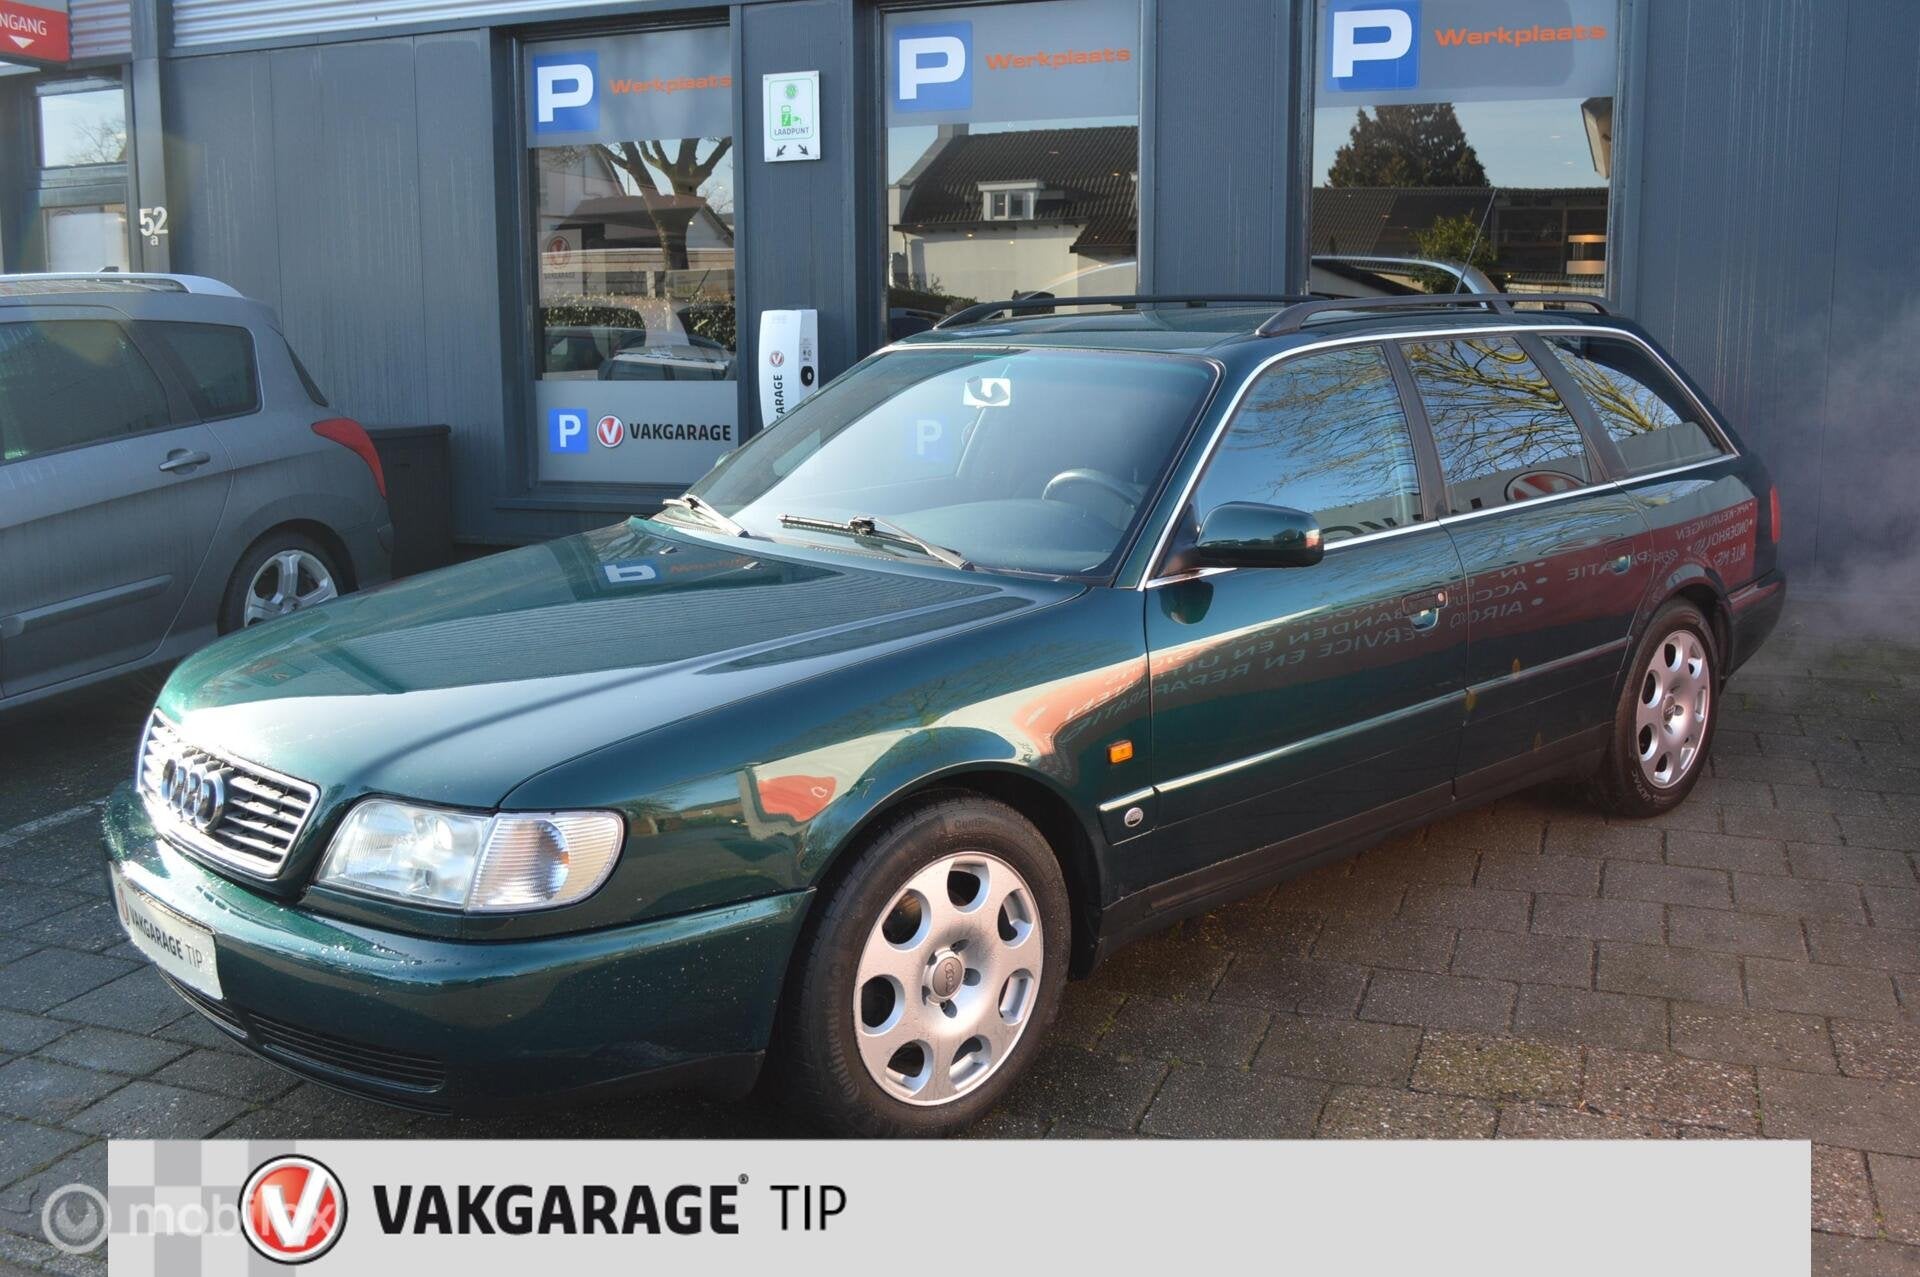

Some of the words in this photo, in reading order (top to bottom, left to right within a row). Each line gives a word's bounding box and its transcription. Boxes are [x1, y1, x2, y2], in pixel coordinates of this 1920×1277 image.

[1332, 9, 1413, 78] P
[1434, 23, 1607, 49] Werkplaats
[899, 35, 965, 99] P
[985, 46, 1131, 70] Werkplaats
[537, 64, 594, 122] P
[609, 75, 732, 96] Werkplaats
[774, 127, 809, 136] LAADPUNT
[139, 206, 168, 236] 52
[150, 235, 158, 246] a
[773, 374, 785, 420] ARAGE
[558, 414, 581, 447] P
[630, 423, 731, 441] VAKGARAGE
[915, 419, 943, 455] P
[129, 904, 183, 960] VAKGARAGE
[185, 944, 203, 968] TIP
